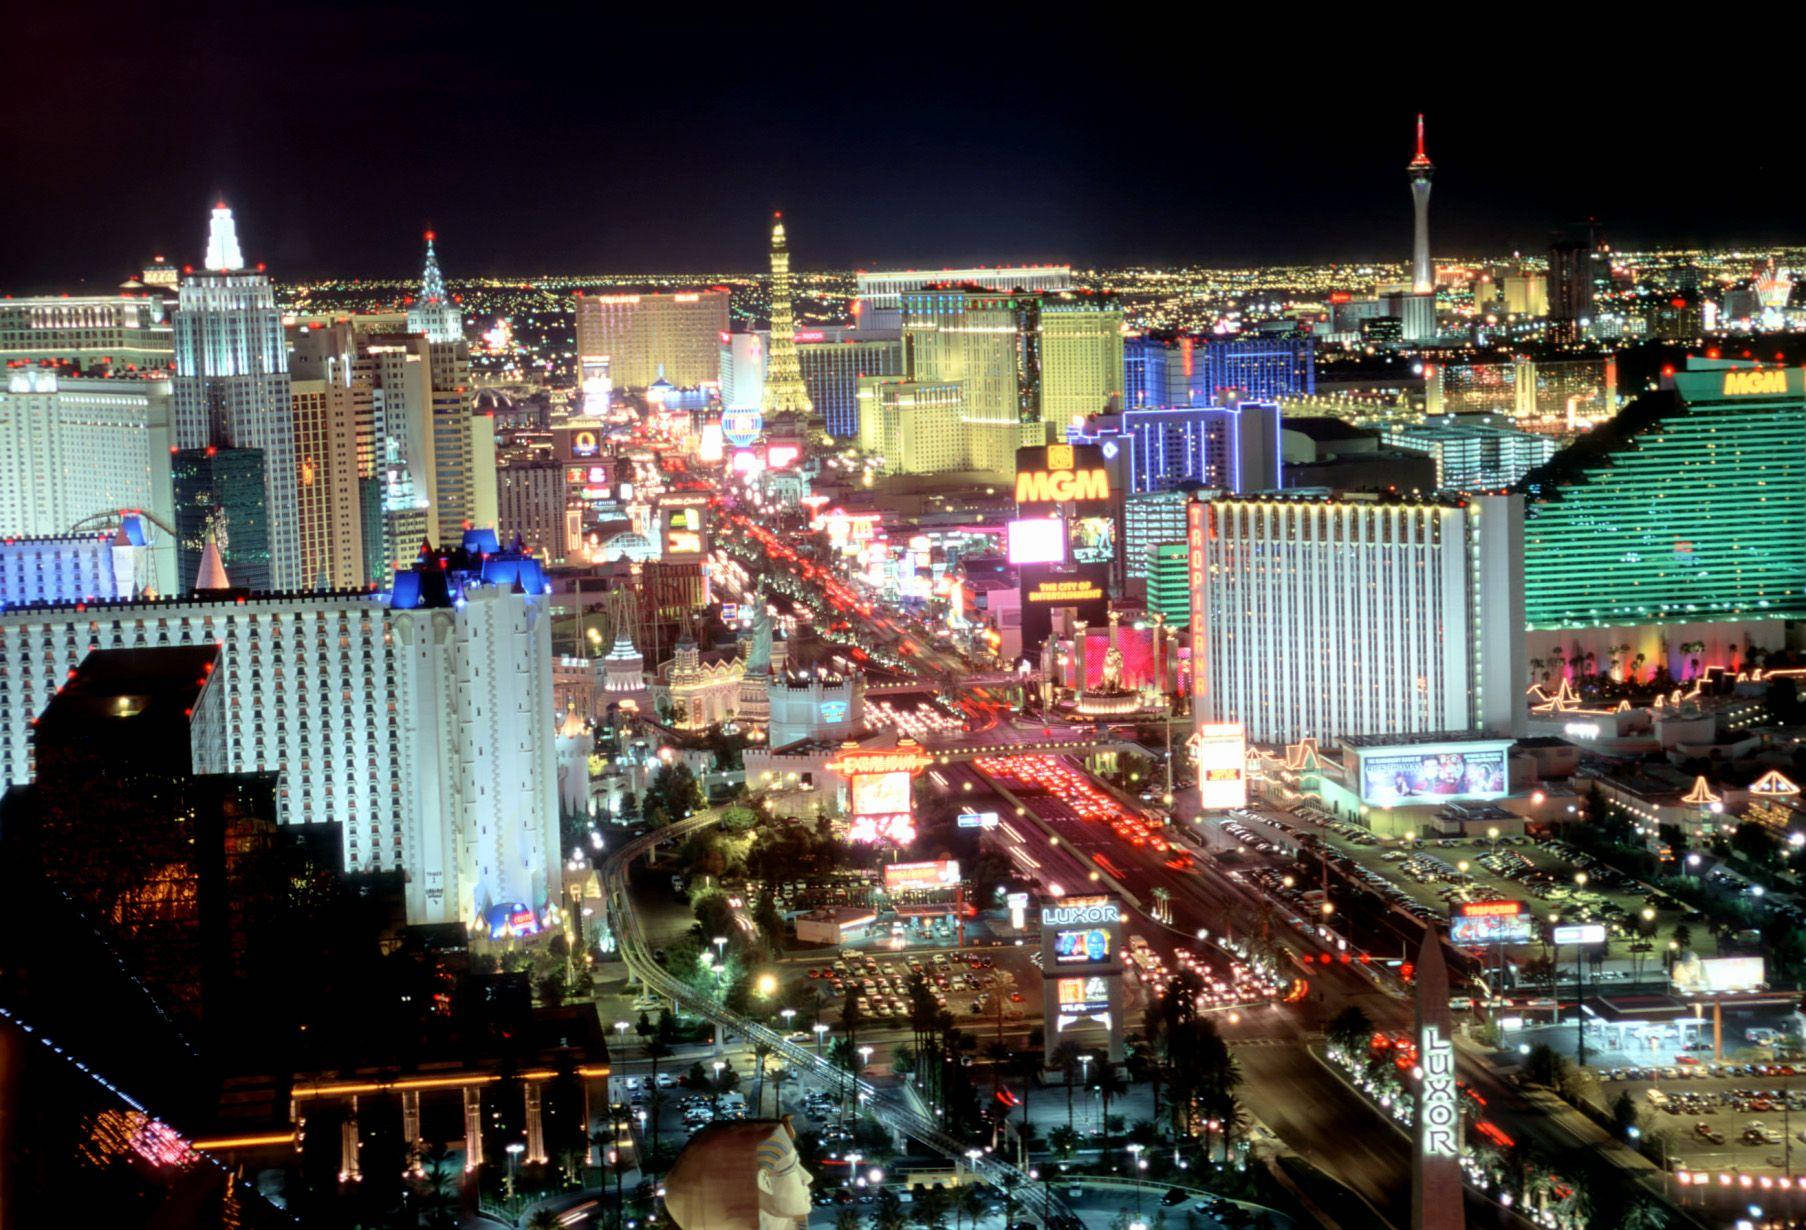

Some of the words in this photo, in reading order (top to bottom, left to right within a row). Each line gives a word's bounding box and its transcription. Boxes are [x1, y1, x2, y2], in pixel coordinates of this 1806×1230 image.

[1723, 369, 1787, 396] MGM
[1015, 468, 1110, 503] MGM
[1058, 581, 1078, 592] CITY
[1078, 580, 1092, 591] OF
[1190, 506, 1207, 697] TROPICANA
[1042, 906, 1119, 925] LUXOR
[1423, 1026, 1458, 1157] LUXOR
